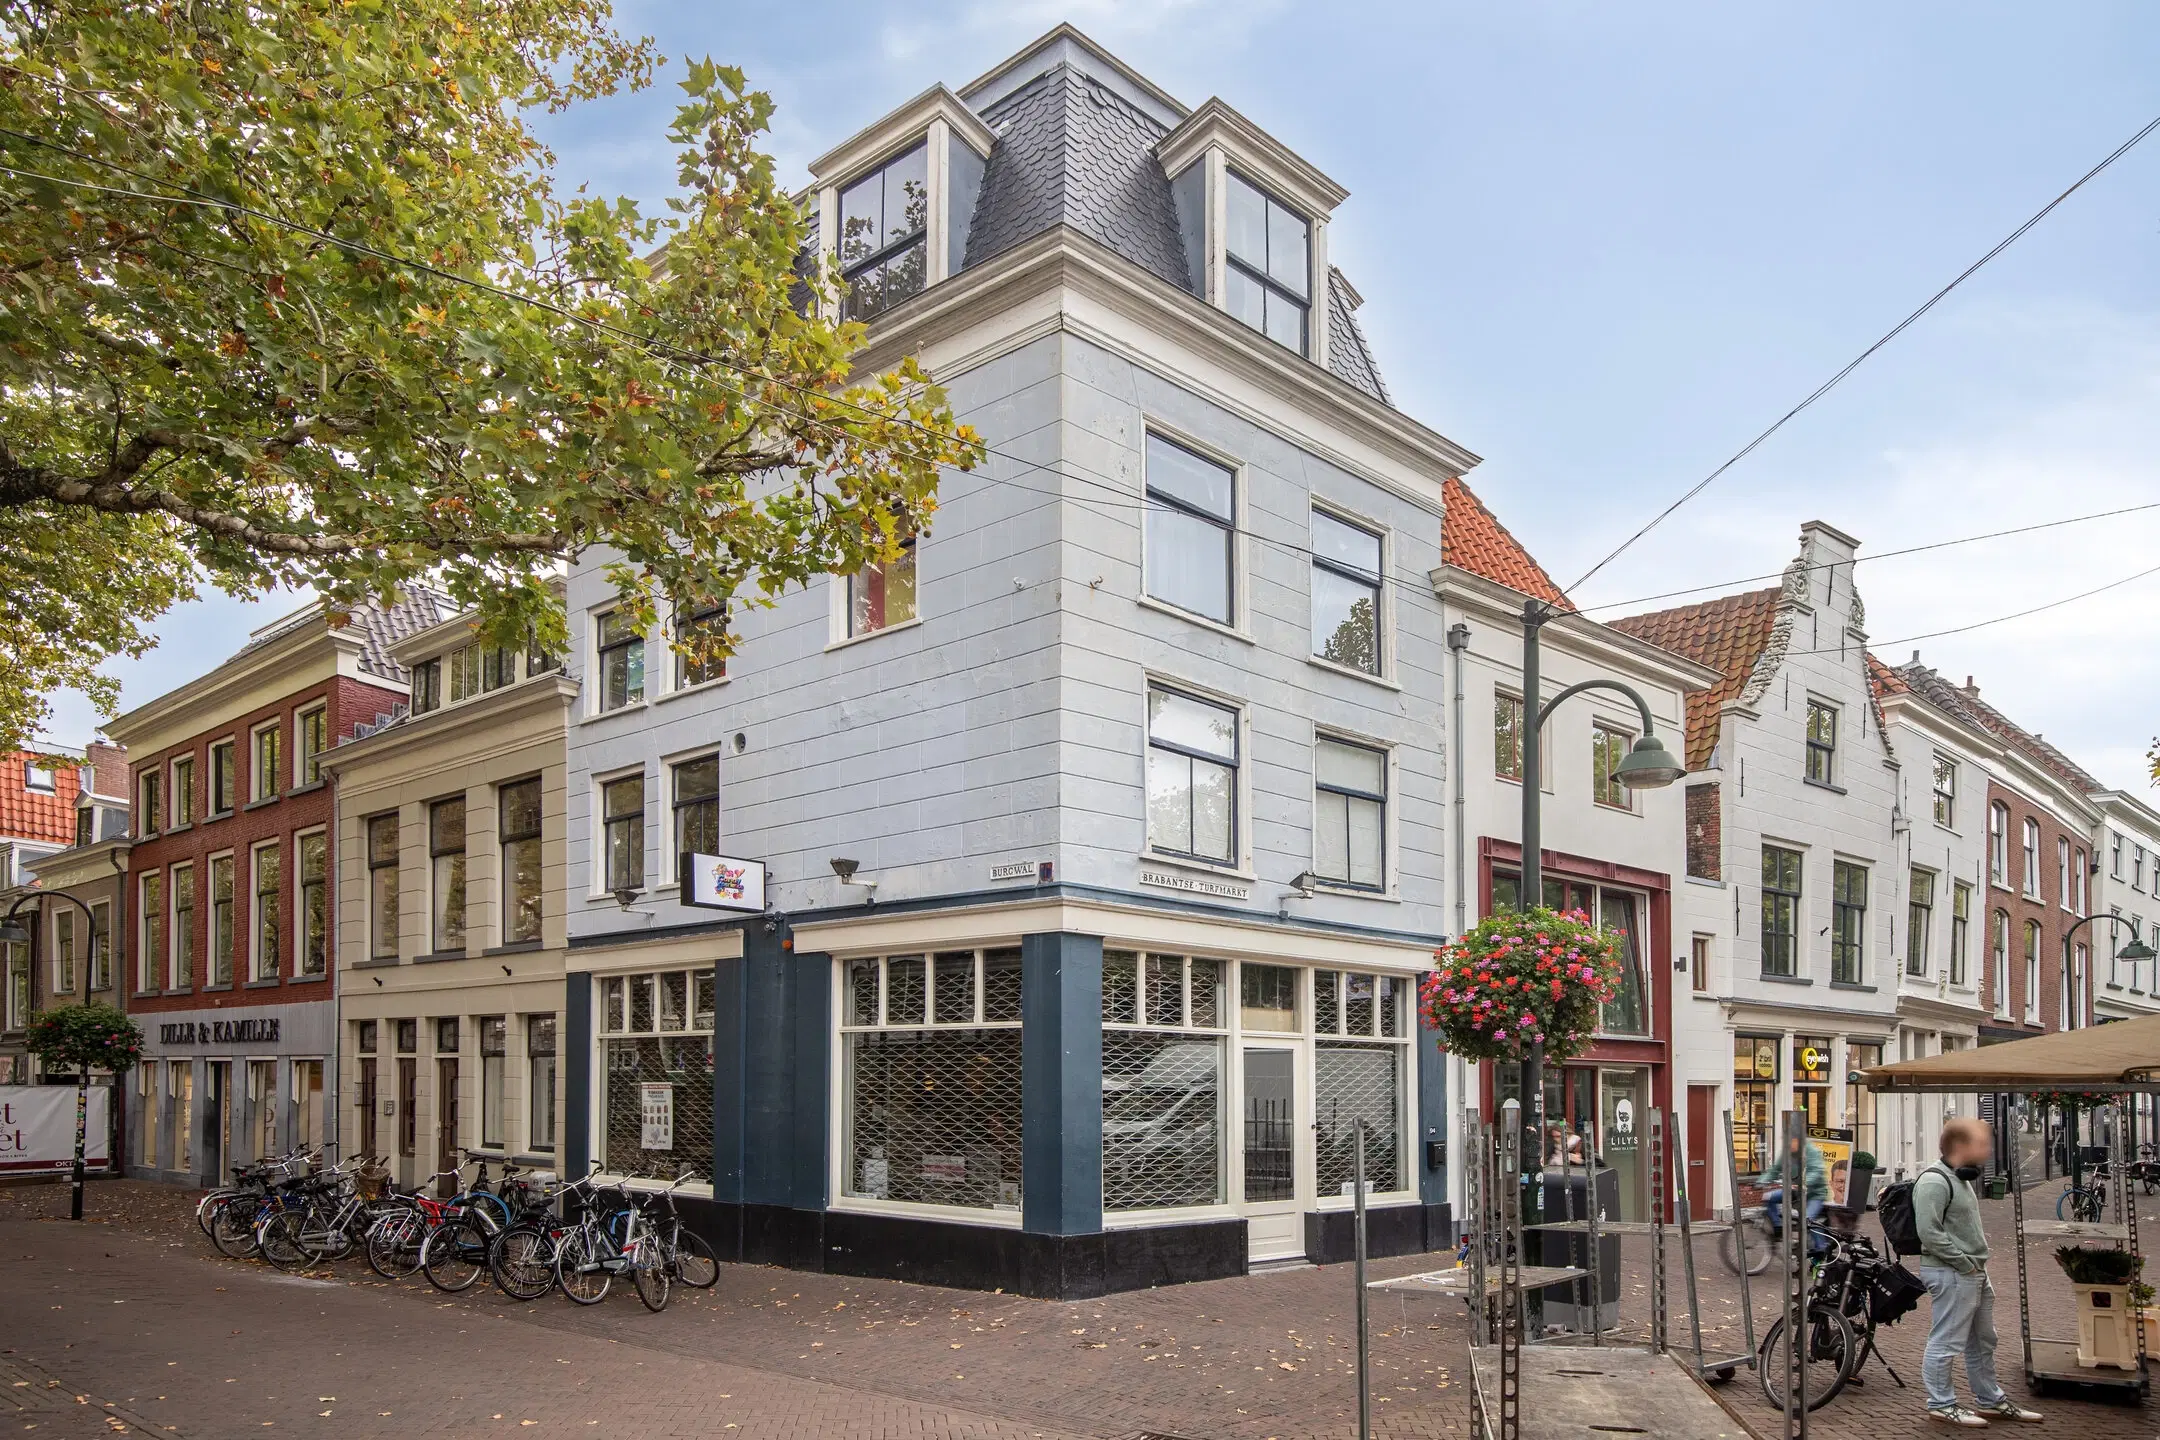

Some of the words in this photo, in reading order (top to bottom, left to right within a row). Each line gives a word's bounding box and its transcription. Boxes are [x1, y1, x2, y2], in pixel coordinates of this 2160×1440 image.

[992, 864, 1033, 877] BURGWAL
[160, 1022, 195, 1044] DILLE
[198, 1022, 210, 1044] &
[212, 1018, 279, 1043] KAMILLE
[1611, 1136, 1639, 1146] LILY'S
